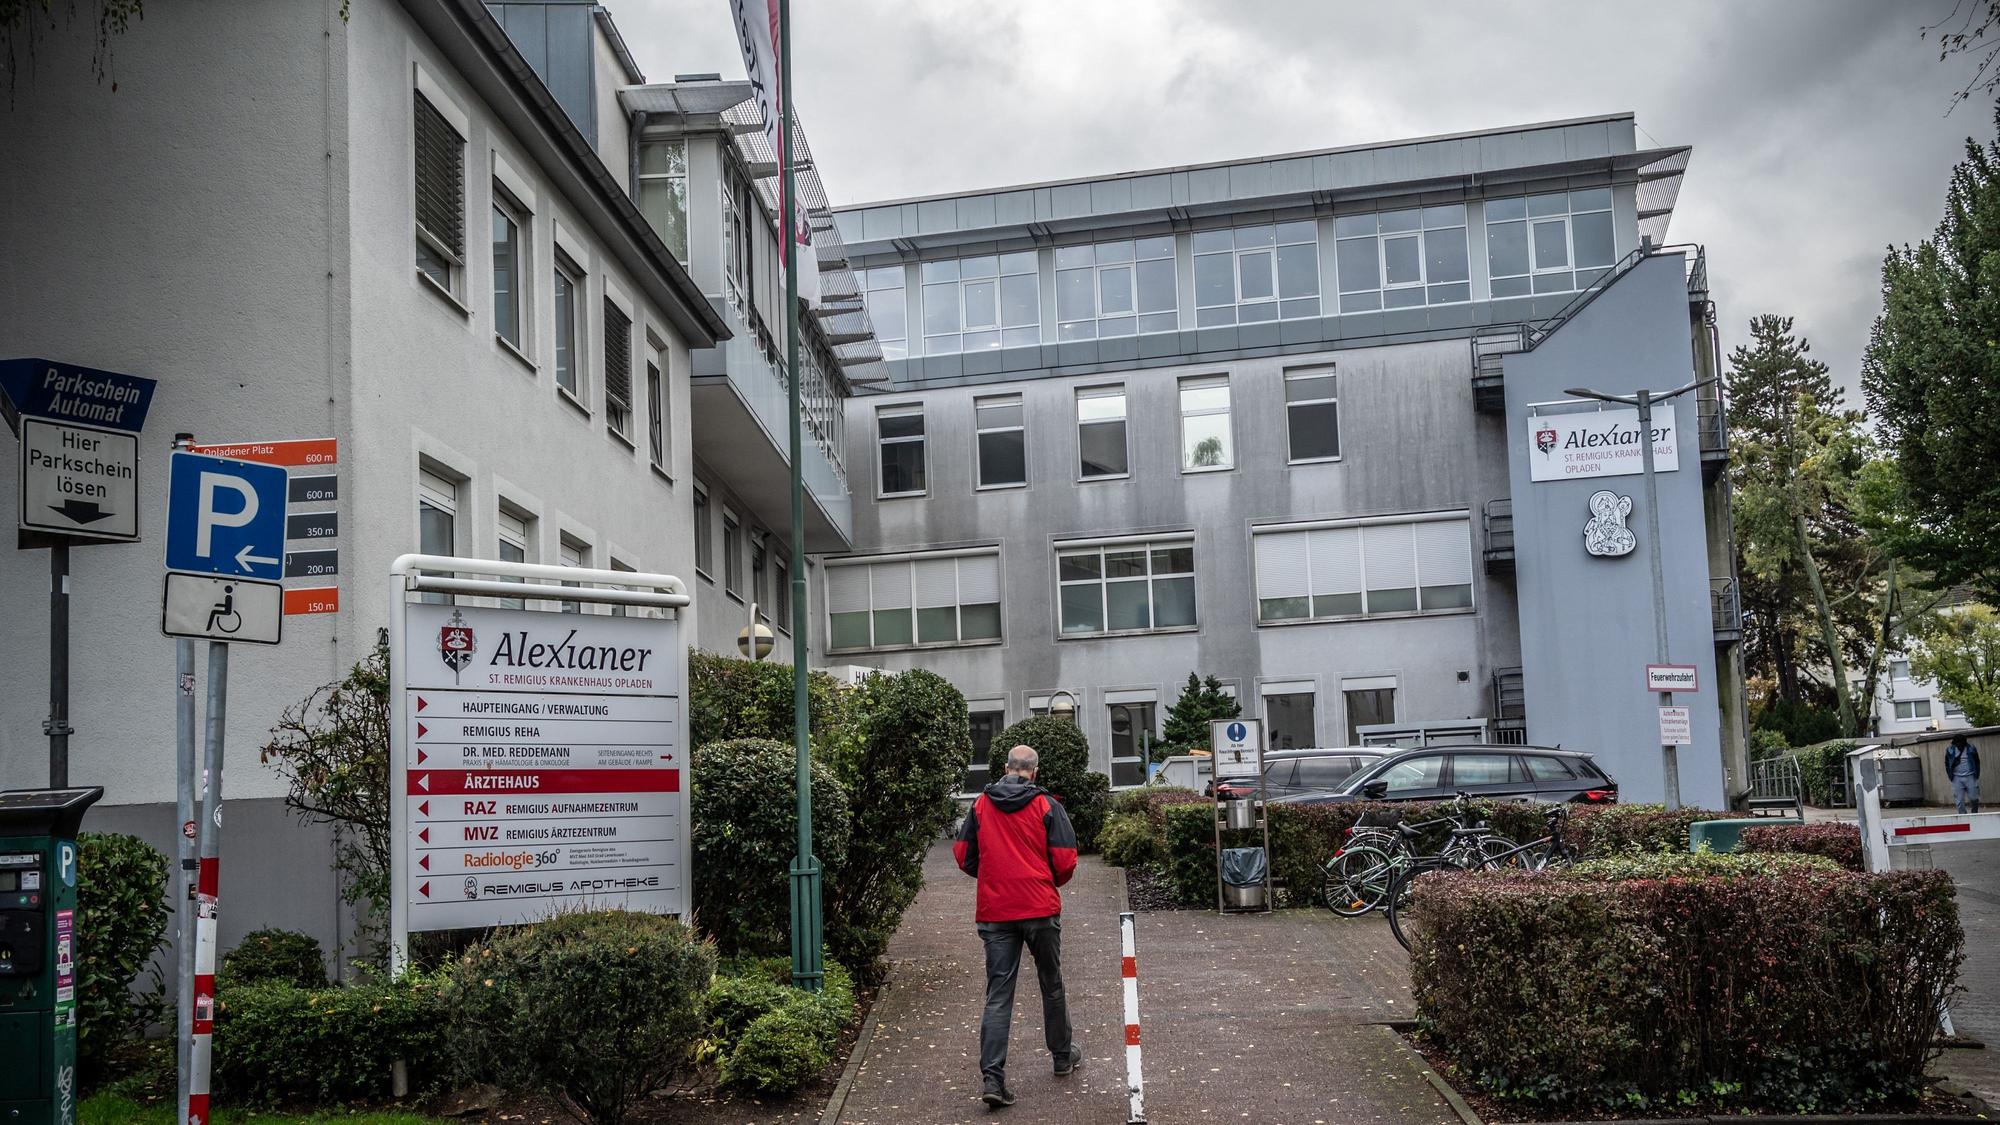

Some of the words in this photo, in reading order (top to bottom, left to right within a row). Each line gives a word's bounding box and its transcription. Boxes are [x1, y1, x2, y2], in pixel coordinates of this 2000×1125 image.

[44, 368, 140, 404] Parkschein
[48, 392, 124, 423] Automat
[62, 431, 101, 452] Hier
[252, 445, 274, 455] Platz
[1564, 454, 1575, 462] ST.
[1576, 451, 1613, 462] REMIGIUS
[30, 449, 132, 479] Parkschein
[306, 453, 322, 463] 600
[324, 454, 333, 462] m
[1565, 463, 1601, 474] OPLADEN
[57, 475, 106, 498] lösen
[306, 490, 323, 499] 600
[325, 491, 334, 499] m
[196, 471, 259, 558] P
[307, 528, 323, 537] 350
[307, 565, 324, 574] 200
[325, 565, 335, 573] m
[308, 602, 324, 612] 150
[325, 603, 335, 611] m
[490, 630, 652, 672] Alexianer
[489, 674, 501, 684] ST.
[504, 674, 547, 685] REMIGIUS
[550, 676, 612, 687] KRANKENHAUS
[615, 678, 653, 689] OPLADEN
[1651, 671, 1694, 682] Feuerwehrzufahrt
[462, 702, 540, 714] HAUPTEINGANG
[542, 704, 546, 714] /
[547, 704, 609, 715] VERWALTUNG
[463, 726, 511, 737] REMIGIUS
[514, 727, 540, 737] REHA
[463, 747, 480, 757] DR.
[482, 747, 506, 757] MED.
[509, 747, 570, 758] REDDEMANN
[464, 773, 540, 789] ÄRZTEHAUS
[464, 801, 496, 815] RAZ
[506, 804, 549, 814] REMIGIUS
[551, 802, 639, 814] AUFNAHMEZENTRUM
[464, 826, 499, 841] MVZ
[506, 829, 549, 840] REMIGIUS
[550, 826, 617, 839] ÄRZTEZENTRUM
[62, 846, 73, 879] P
[483, 881, 564, 896] REMIGIUS
[570, 877, 659, 890] APOTHEKE
